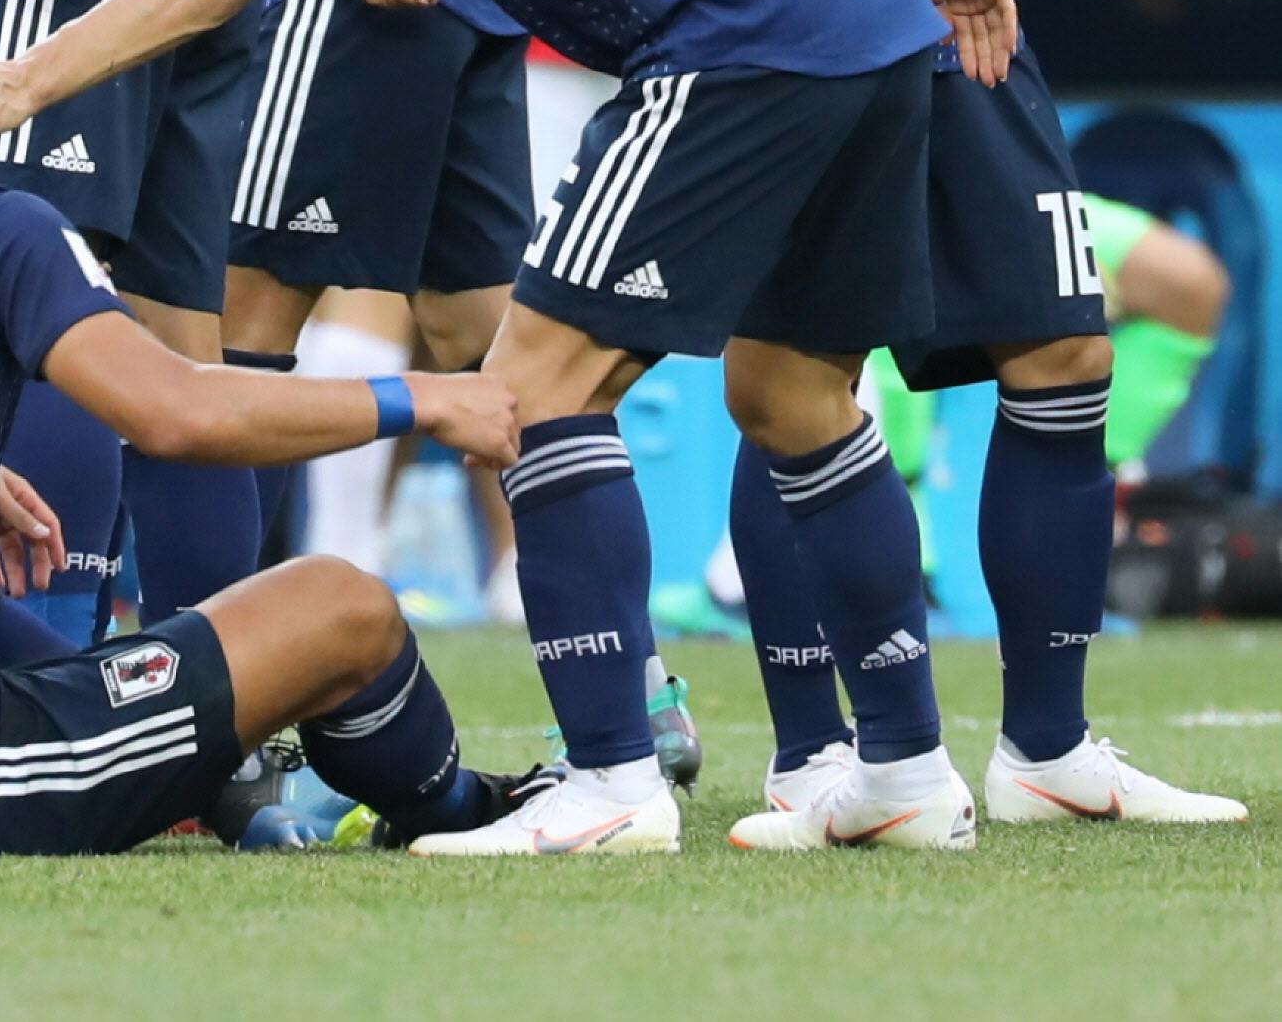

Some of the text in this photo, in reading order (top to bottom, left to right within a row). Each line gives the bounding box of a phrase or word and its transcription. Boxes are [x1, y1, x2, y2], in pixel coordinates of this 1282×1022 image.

[41, 154, 96, 174] adidas
[287, 219, 339, 234] adidas
[613, 281, 669, 300] adidas
[532, 630, 623, 661] APAN
[766, 644, 836, 667] JAPA
[859, 642, 927, 670] adidas
